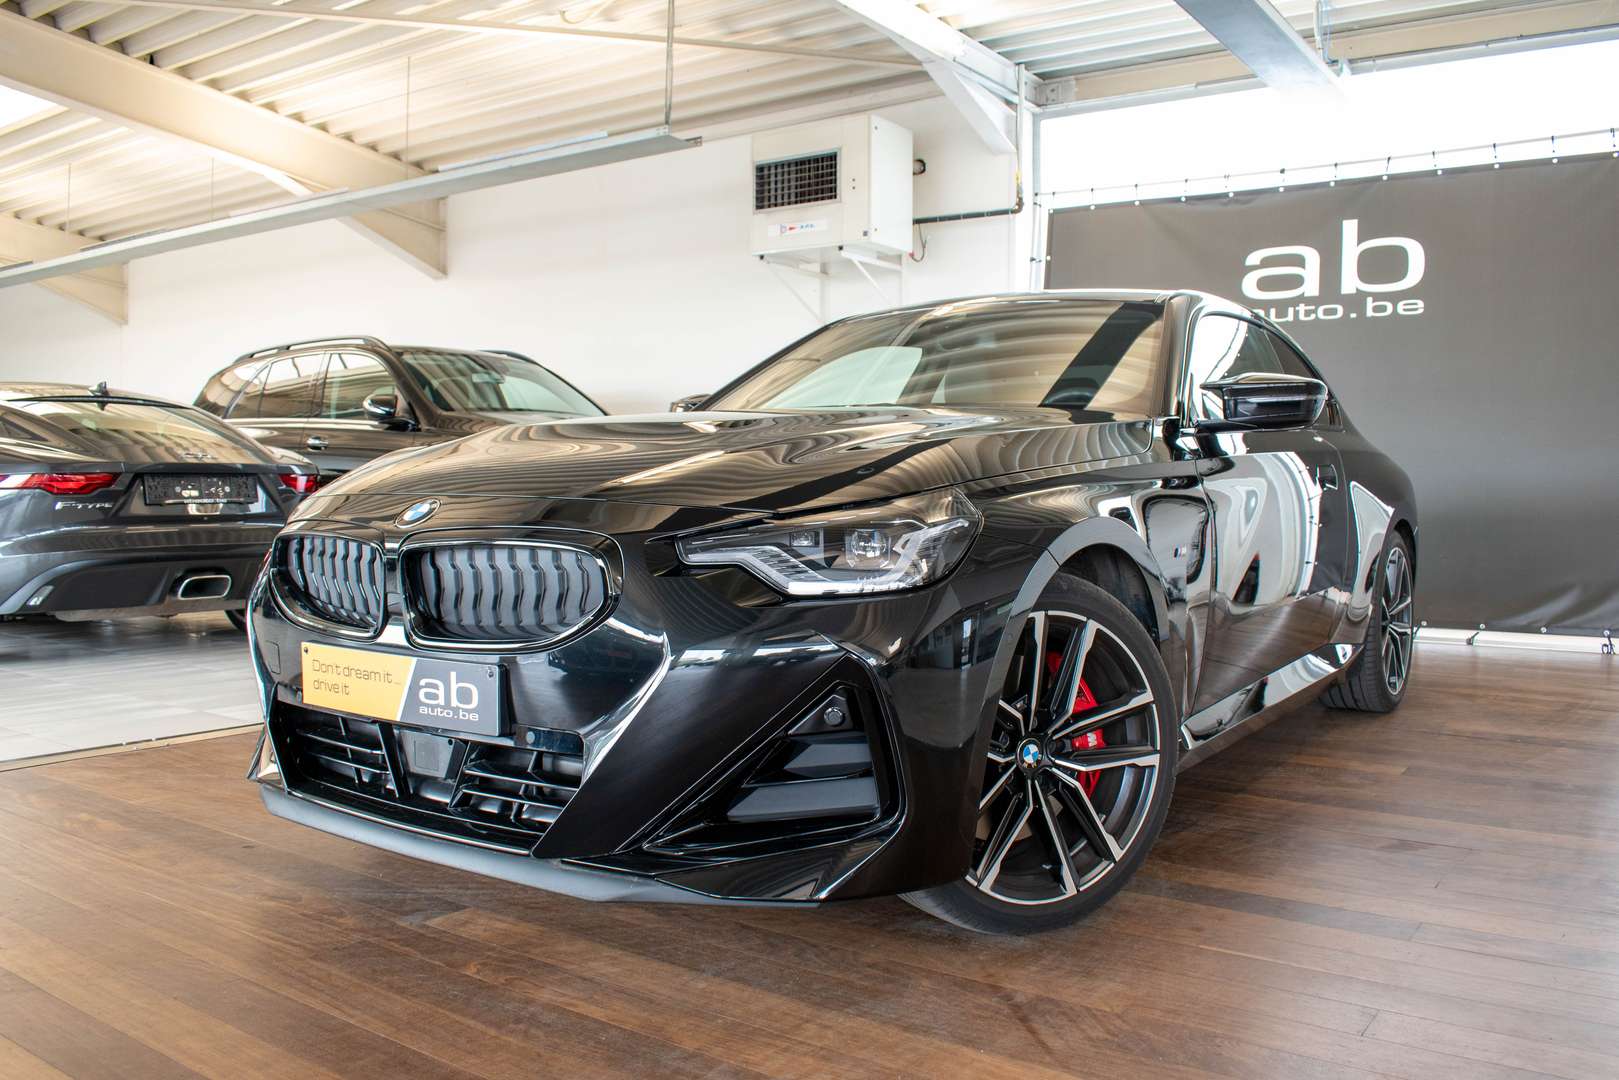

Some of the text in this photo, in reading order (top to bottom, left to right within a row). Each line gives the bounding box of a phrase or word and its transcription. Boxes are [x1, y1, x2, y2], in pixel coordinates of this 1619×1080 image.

[1241, 218, 1426, 300] ab
[342, 665, 381, 682] dream
[313, 679, 340, 694] drive
[418, 671, 479, 710] ab
[418, 706, 479, 721] auto.be
